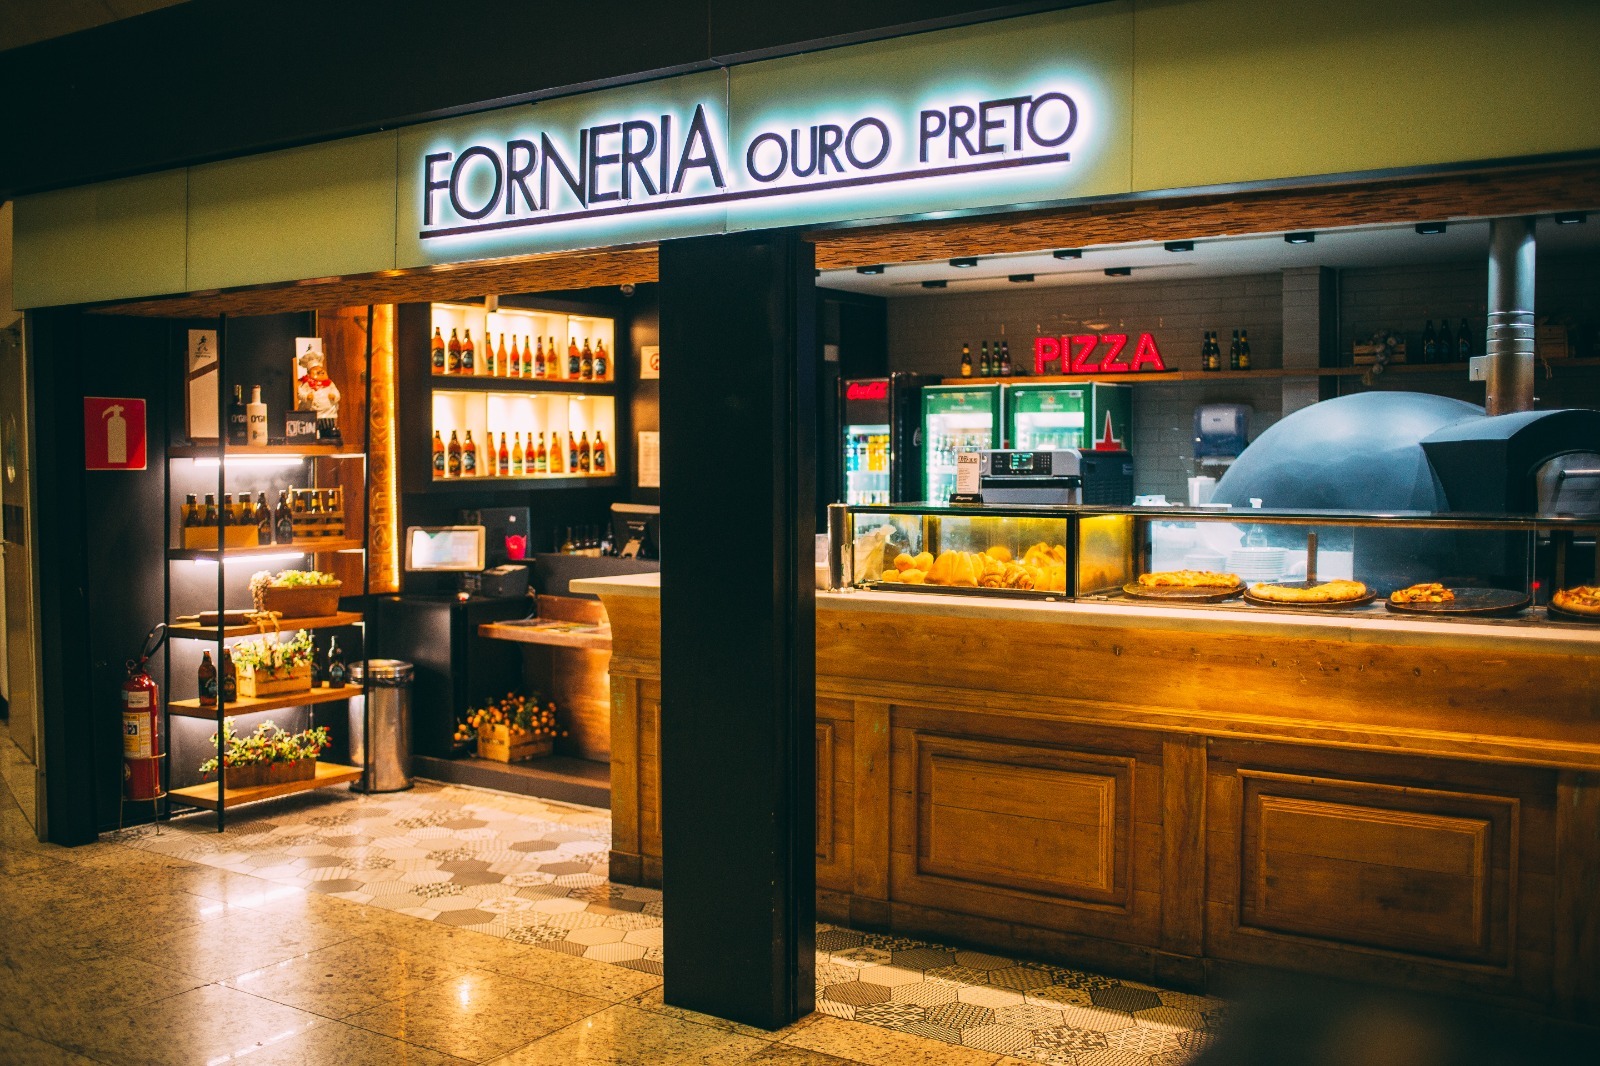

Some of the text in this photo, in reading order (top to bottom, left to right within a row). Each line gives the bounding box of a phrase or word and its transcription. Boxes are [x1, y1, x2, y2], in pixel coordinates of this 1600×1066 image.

[424, 92, 1078, 226] FORNERIA OURO PRETO
[1034, 333, 1165, 374] PIZZA
